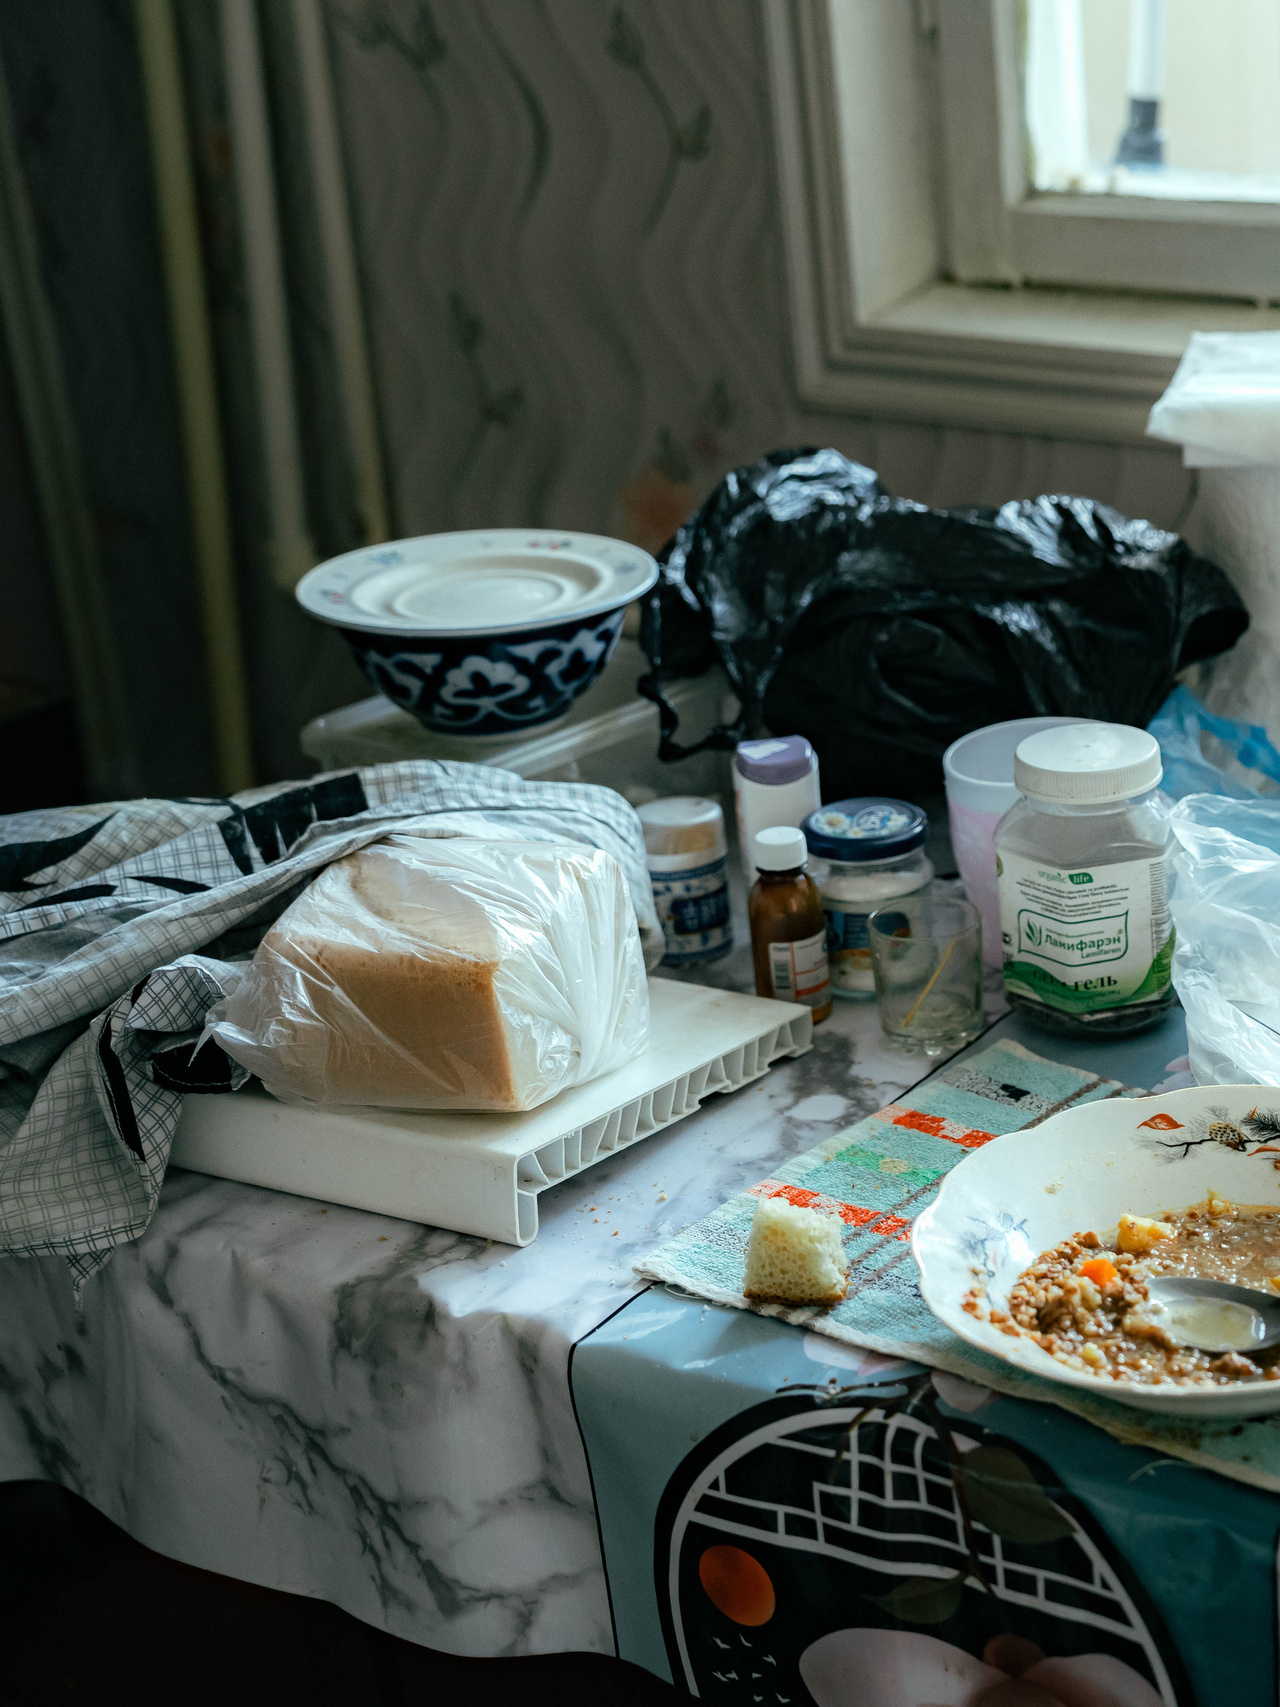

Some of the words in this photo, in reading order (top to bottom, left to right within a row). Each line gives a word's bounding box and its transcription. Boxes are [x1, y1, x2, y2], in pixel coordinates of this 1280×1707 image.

[1038, 870, 1067, 884] organic
[1073, 874, 1090, 884] life
[1045, 934, 1121, 952] Ламифарэн
[1074, 975, 1118, 992] гель
